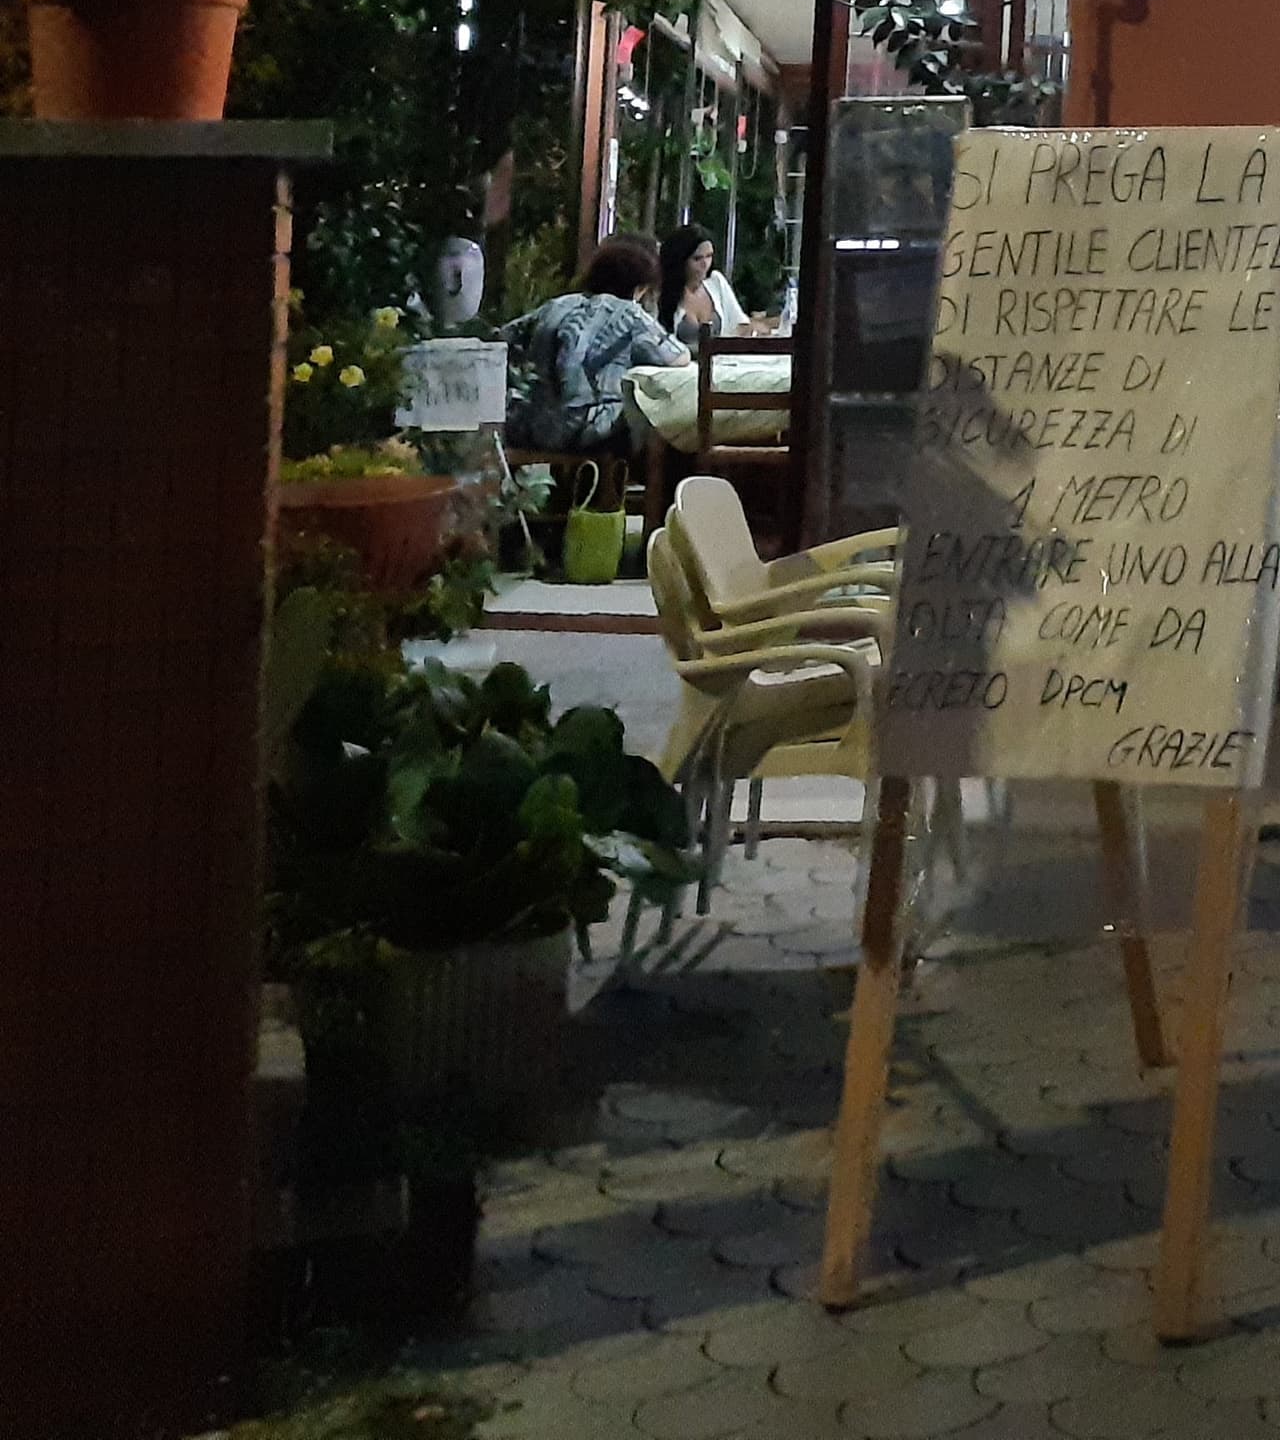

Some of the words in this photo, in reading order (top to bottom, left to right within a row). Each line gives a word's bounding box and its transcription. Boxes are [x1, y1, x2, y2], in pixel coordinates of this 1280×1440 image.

[951, 147, 1000, 210] SI
[1025, 143, 1167, 205] PREGA
[1196, 143, 1268, 204] LA
[942, 229, 1110, 278] GENTILE
[936, 293, 970, 336] DI
[996, 288, 1208, 336] RISPETTARE
[1229, 291, 1276, 332] LE
[928, 350, 1106, 393] DISTANZE
[1122, 355, 1167, 392] DI
[922, 406, 1137, 452] SICUREZZA
[1161, 414, 1198, 456] DI
[1009, 477, 1036, 530] 1
[1050, 474, 1189, 526] METRO
[914, 532, 1095, 589] ENTRARE
[1107, 542, 1188, 587] UNO
[908, 597, 1005, 644] OLTA
[1038, 600, 1129, 651] COME
[1150, 607, 1207, 655] DA
[886, 670, 1009, 710] ECRETO
[1040, 669, 1129, 715] DPCM
[1106, 725, 1257, 771] GRAZIE
